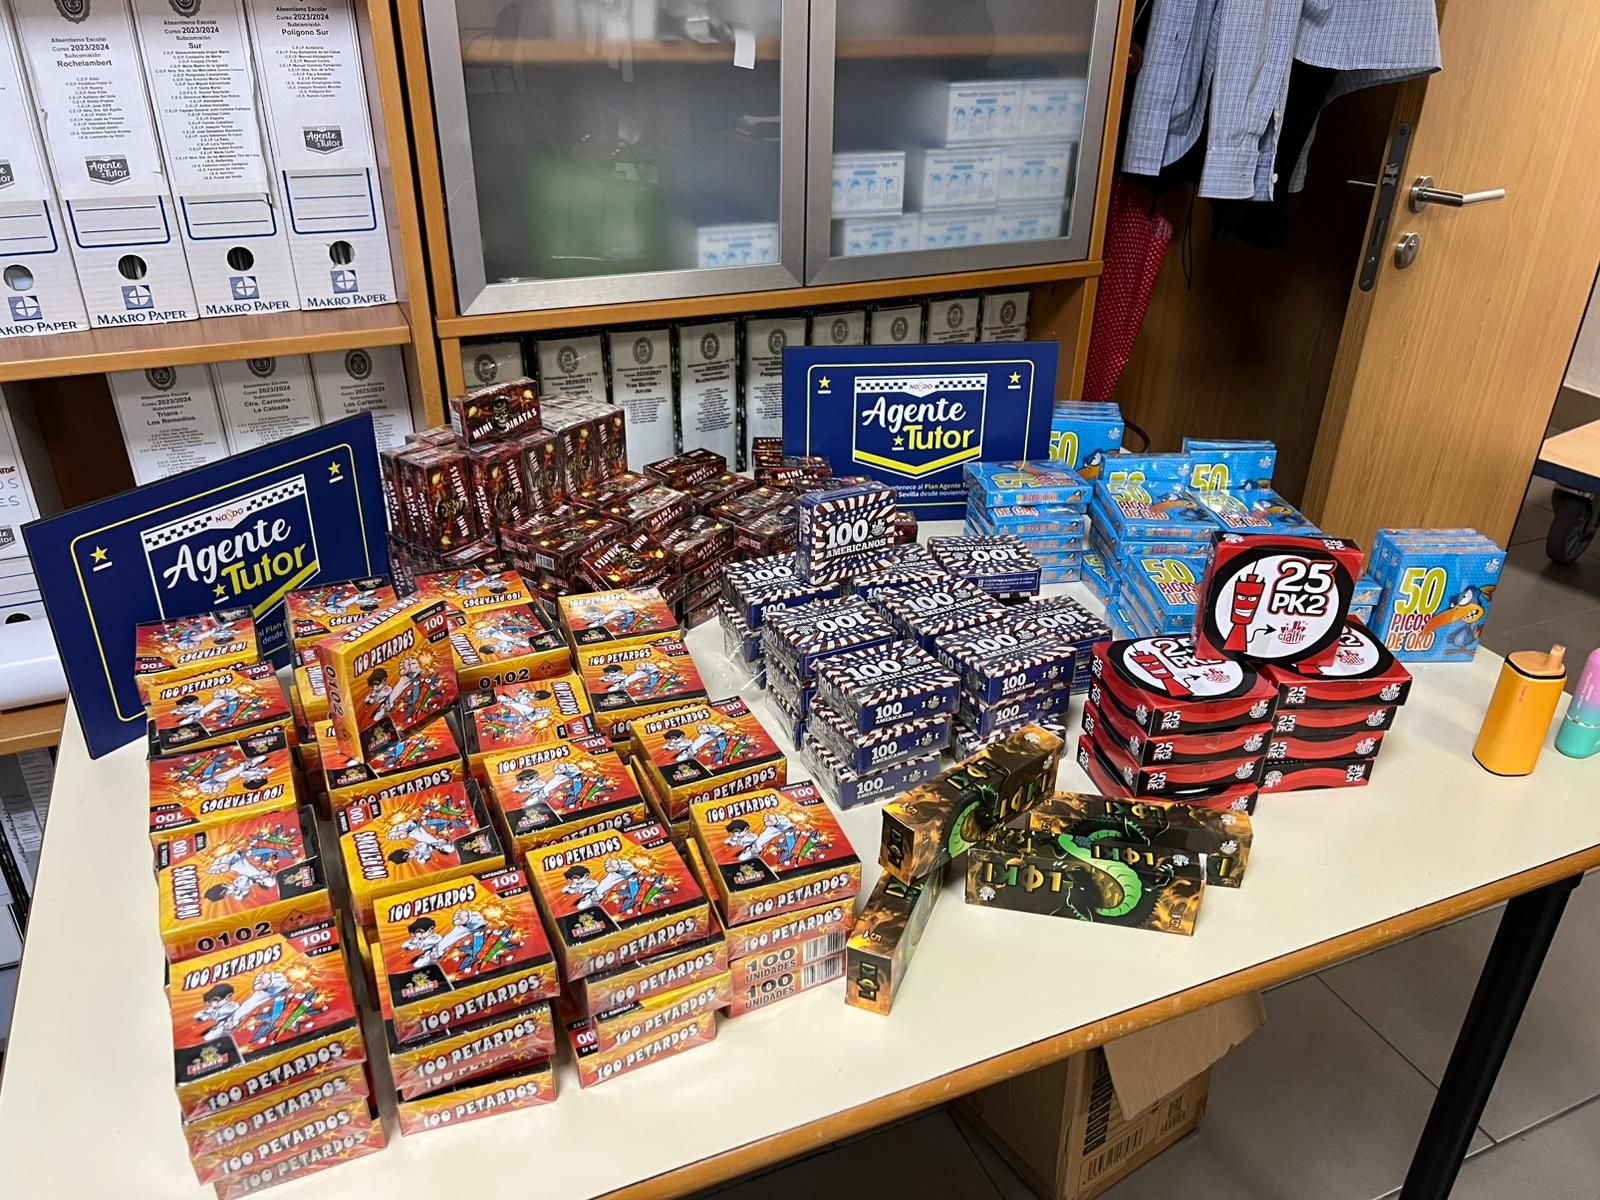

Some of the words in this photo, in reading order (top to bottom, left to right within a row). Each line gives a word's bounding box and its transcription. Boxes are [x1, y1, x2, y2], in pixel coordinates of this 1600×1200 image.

[306, 130, 336, 143] Agente
[321, 138, 342, 148] Tutor
[89, 160, 124, 176] Agente
[105, 168, 129, 179] Tutor
[206, 304, 251, 314] MAKRO
[254, 300, 290, 310] PAPER
[307, 297, 349, 308] MAKRO
[351, 294, 387, 305] PAPER
[38, 320, 78, 333] PAPER
[98, 312, 146, 325] MAKRO
[149, 310, 187, 321] PAPER
[472, 422, 493, 439] MINI
[504, 408, 538, 432] PIRATAS
[862, 396, 966, 434] Agente
[903, 425, 975, 450] Tutor
[777, 469, 803, 480] MINI
[1191, 464, 1229, 492] 50
[940, 482, 962, 490] Agente
[650, 506, 672, 526] MINI
[1123, 508, 1140, 519] DE
[457, 515, 470, 537] MINI
[825, 519, 869, 549] 100
[163, 517, 292, 588] Agente
[631, 534, 648, 551] MINI
[826, 537, 886, 558] AMERICANOS
[972, 549, 1023, 562] 100
[220, 541, 307, 596] Tutor
[741, 566, 793, 583] 100
[1142, 559, 1194, 584] 50
[1276, 559, 1337, 593] 25
[1163, 593, 1184, 605] DE
[1394, 567, 1448, 614] 50
[904, 592, 953, 612] 100
[917, 597, 983, 618] AMERICANOS
[1269, 593, 1327, 616] PK2
[265, 622, 282, 634] Plan
[816, 611, 870, 633] 100
[1391, 613, 1431, 632] PICOS
[263, 632, 284, 645] desde
[965, 634, 1017, 654] 100
[982, 637, 1048, 660] AMERICANOS
[1386, 632, 1405, 648] DE
[1406, 632, 1434, 650] ORO
[178, 647, 228, 663] PETARDOS
[354, 659, 370, 677] 100
[370, 629, 415, 668] PETARDOS
[589, 655, 606, 666] 100
[607, 648, 651, 663] PETARDOS
[480, 668, 530, 689] 0102
[845, 660, 901, 682] 100
[859, 664, 933, 687] AMERICANOS
[1002, 673, 1026, 690] 100
[161, 688, 180, 700] 100
[182, 674, 232, 695] PETARDOS
[324, 664, 344, 716] 0102
[1289, 686, 1306, 697] 25
[720, 702, 742, 712] 100
[1286, 695, 1305, 704] PK2
[645, 721, 663, 734] 100
[664, 709, 710, 730] PETARDOS
[875, 703, 903, 719] 100
[1163, 711, 1181, 722] 25
[1161, 720, 1179, 729] PK2
[497, 760, 518, 775] 100
[518, 746, 570, 769] PETARDOS
[201, 790, 260, 814] PETARDOS
[261, 784, 284, 799] 100
[707, 807, 727, 823] 100
[727, 795, 778, 820] PETARDOS
[634, 828, 660, 840] 100
[543, 854, 564, 871] 100
[565, 837, 622, 864] PETARDOS
[491, 873, 520, 888] 100
[388, 902, 413, 923] 100
[413, 884, 475, 917] PETARDOS
[749, 901, 775, 917] 100
[777, 873, 848, 908] PETARDOS
[197, 922, 272, 950] 0102
[302, 931, 331, 946] 100
[744, 935, 769, 952] 100
[772, 907, 842, 942] PETARDOS
[589, 953, 615, 971] 100
[619, 918, 695, 960] PETARDOS
[182, 969, 213, 991] 100
[214, 944, 281, 981] PETARDOS
[747, 948, 796, 972] 100
[745, 959, 796, 983] UNIDADES
[746, 973, 794, 998] 100
[420, 1011, 451, 1033] 100
[455, 975, 540, 1020] PETARDOS
[745, 986, 794, 1009] UNIDADES
[207, 1088, 243, 1109] 100
[246, 1042, 344, 1095] PETARDOS
